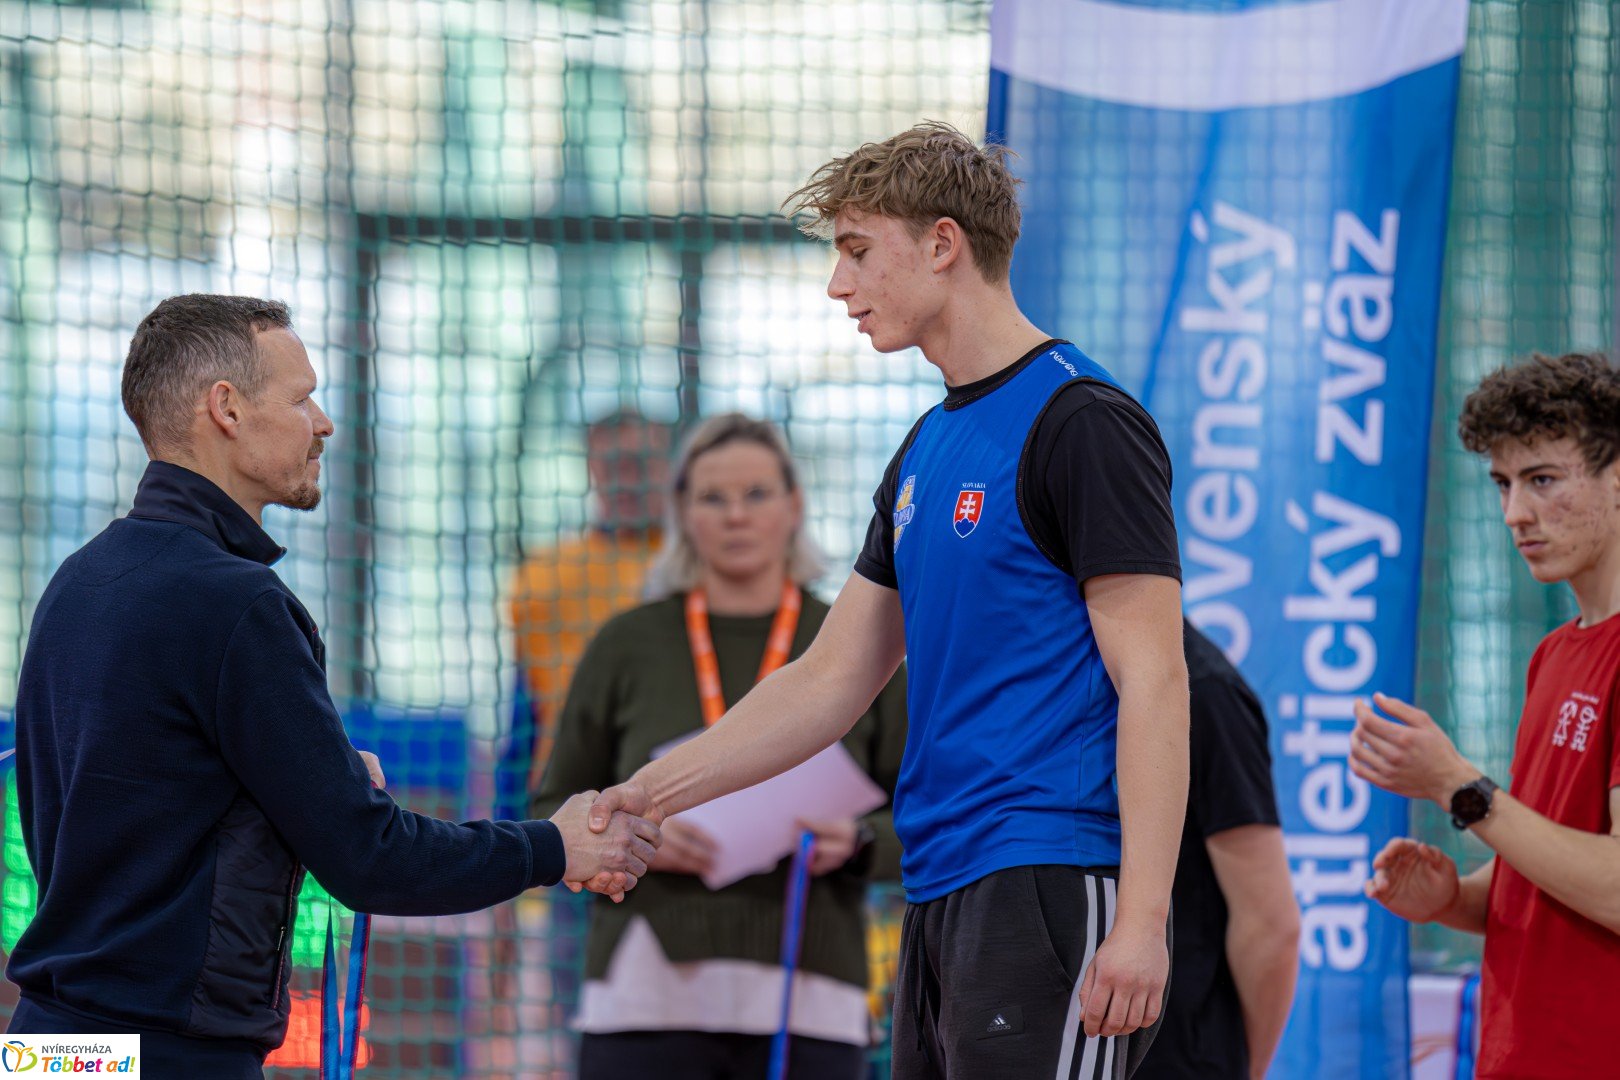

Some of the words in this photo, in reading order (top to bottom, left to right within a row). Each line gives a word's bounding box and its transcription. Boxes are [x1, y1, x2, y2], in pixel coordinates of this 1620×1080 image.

[1180, 201, 1296, 667] ovenský
[1302, 208, 1399, 466] zväz
[1278, 491, 1401, 971] atletický
